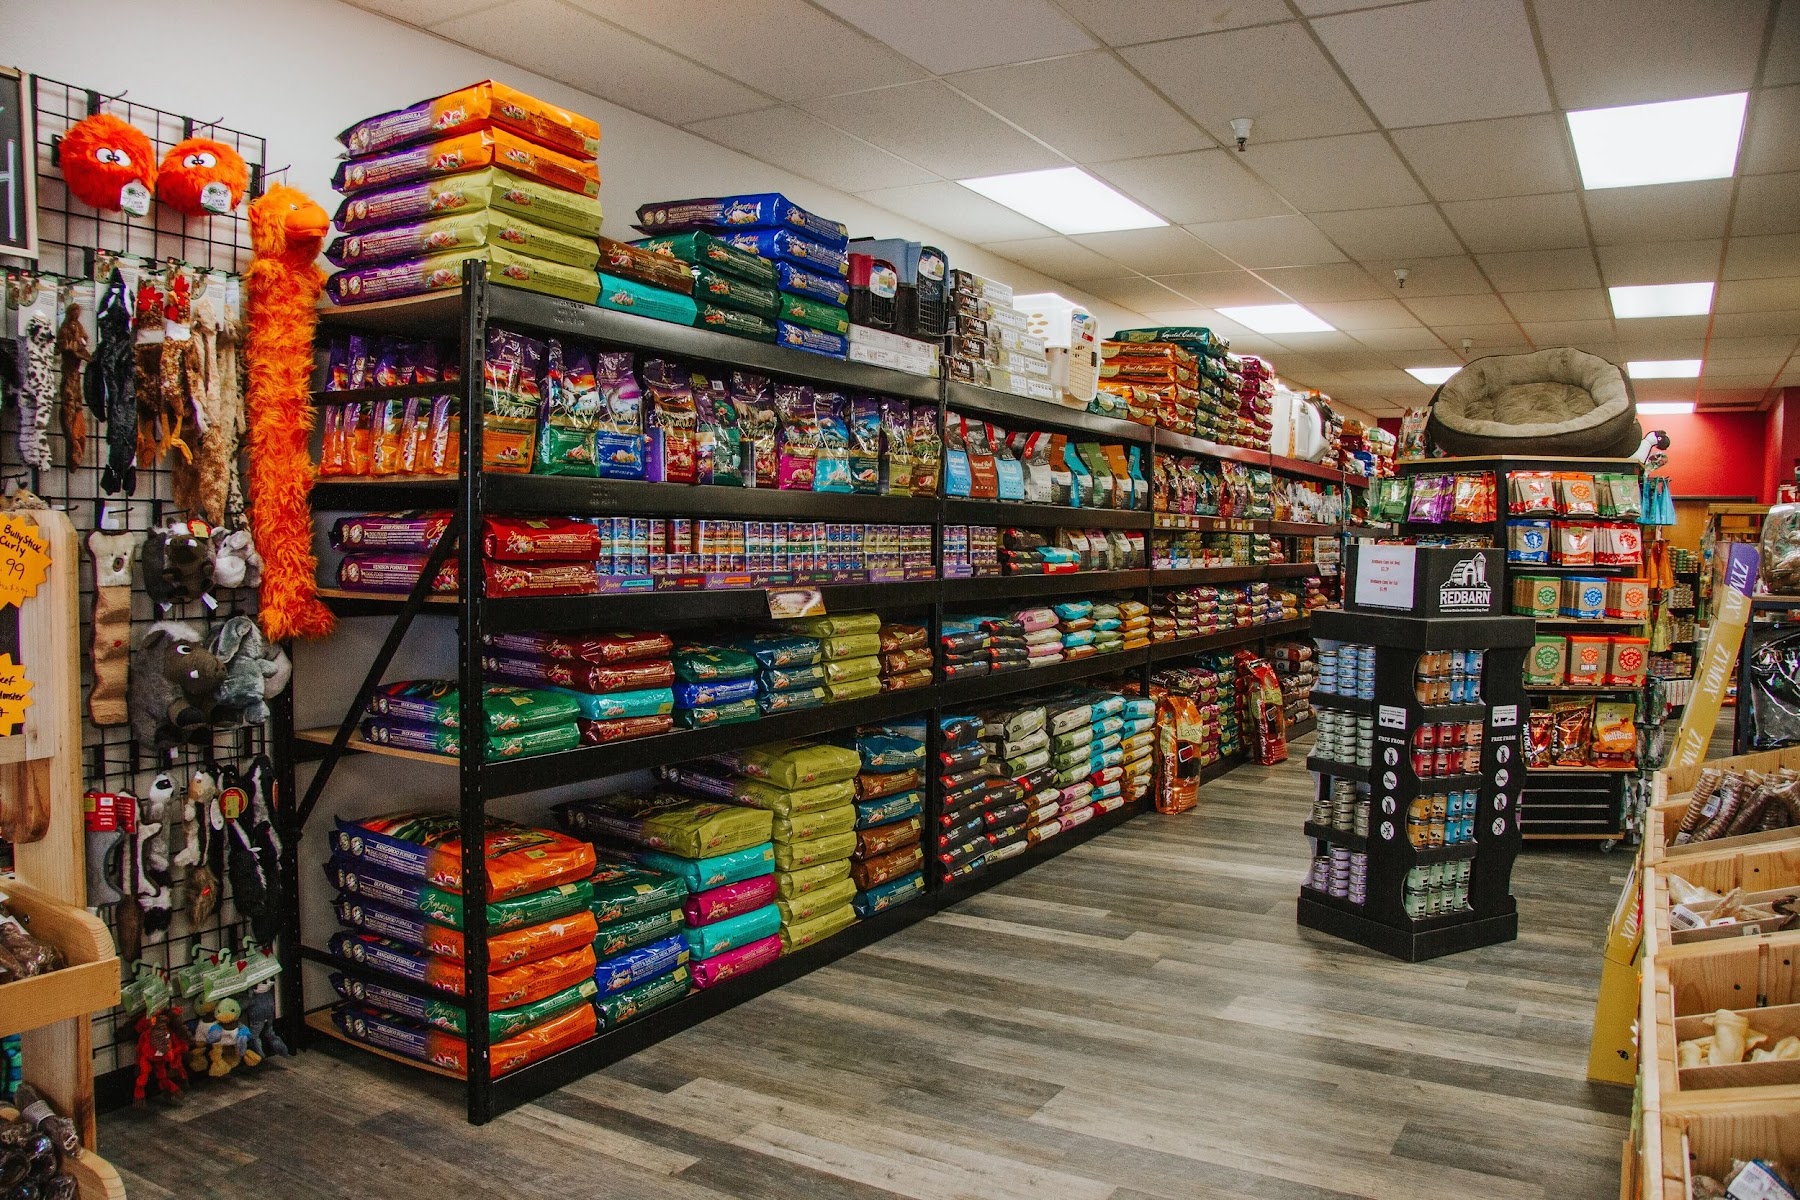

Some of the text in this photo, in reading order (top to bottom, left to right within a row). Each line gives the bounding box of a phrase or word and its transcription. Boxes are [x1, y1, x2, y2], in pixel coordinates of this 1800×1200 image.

[0, 535, 26, 558] Curly
[4, 524, 24, 544] Bully
[1440, 591, 1491, 604] REDBARN
[1725, 558, 1749, 619] ZYMOX
[1702, 642, 1731, 700] ZYMOX
[1680, 728, 1703, 768] ZYM
